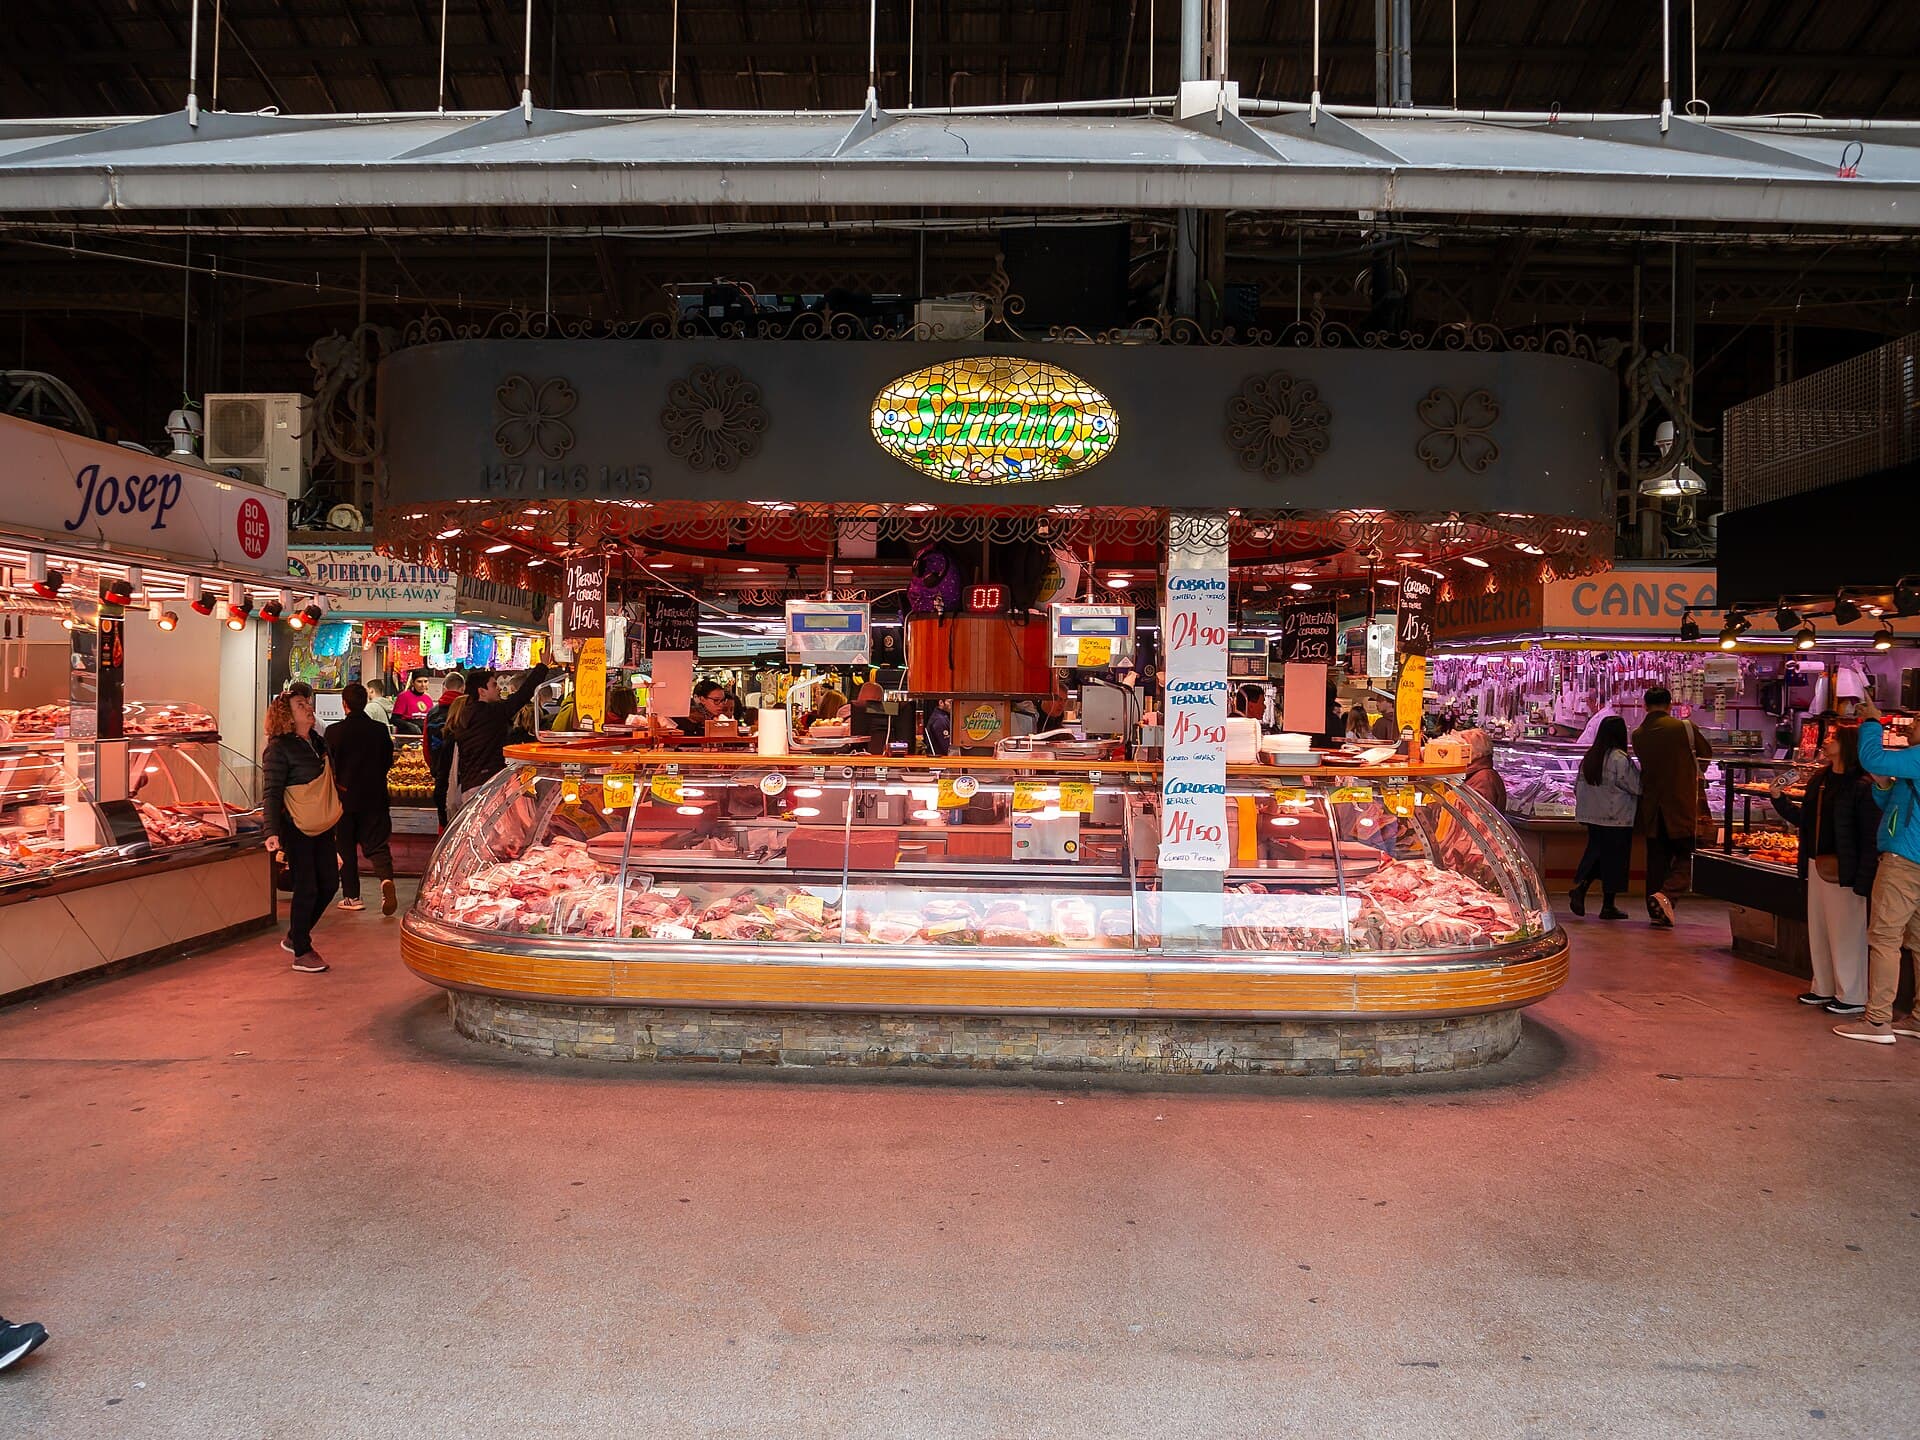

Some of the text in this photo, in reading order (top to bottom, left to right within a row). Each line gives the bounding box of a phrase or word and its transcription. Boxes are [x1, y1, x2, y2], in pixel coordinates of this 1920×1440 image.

[908, 384, 1076, 449] Serrano
[481, 464, 652, 493] 147 146 145
[65, 464, 182, 531] Josep
[245, 502, 259, 519] BO
[245, 519, 265, 539] QUE
[245, 537, 262, 553] RIA
[317, 563, 382, 583] PUERTO
[388, 564, 450, 584] LATINO
[365, 587, 441, 600] TAKE-AWAY
[973, 588, 1000, 608] 00
[1572, 583, 1726, 617] CANSA
[1436, 588, 1531, 628] OCINERIA
[1167, 677, 1227, 691] CORDERO
[1169, 694, 1219, 706] TERUEL
[961, 715, 1002, 731] Serrano
[1164, 777, 1225, 795] CORDERO
[1166, 797, 1198, 806] TERUEL
